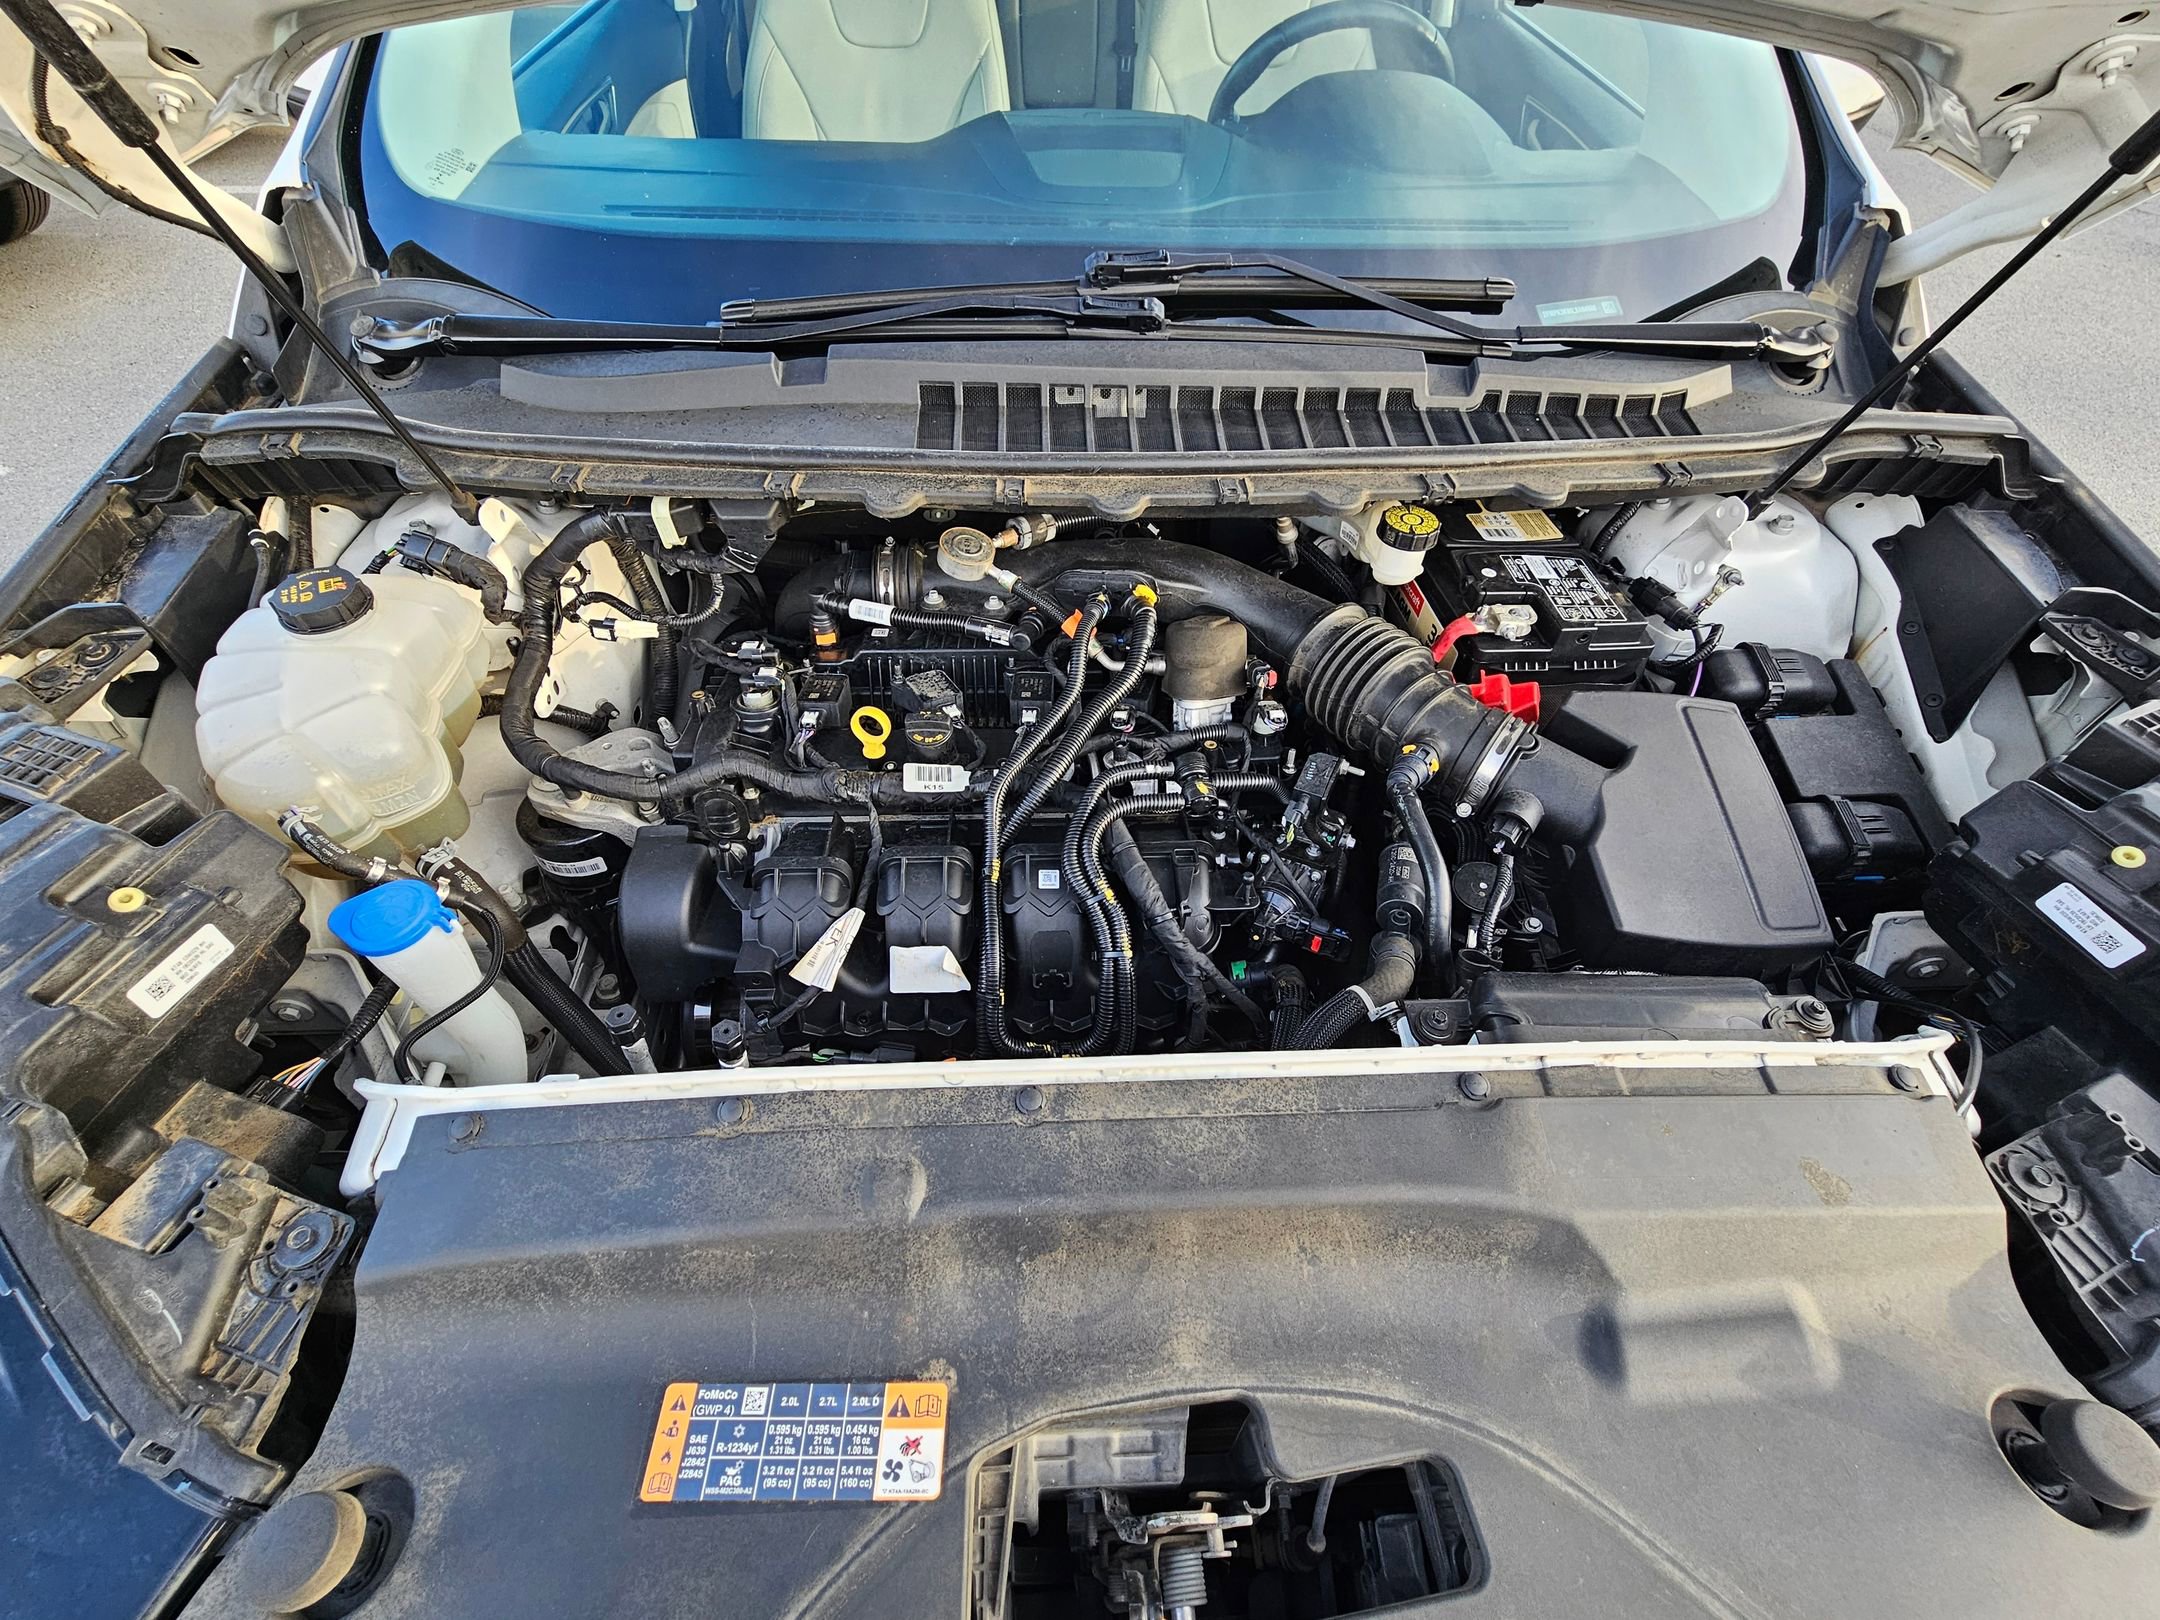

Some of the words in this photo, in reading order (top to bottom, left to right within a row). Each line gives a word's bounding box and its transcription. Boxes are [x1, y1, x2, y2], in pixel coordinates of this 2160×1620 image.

[698, 1389, 738, 1400] FoMoCo
[780, 1396, 800, 1406] 2.0L
[818, 1396, 838, 1406] 2.7L
[851, 1396, 871, 1406] 2.0L
[872, 1396, 880, 1406] D
[692, 1404, 722, 1416] (GWP
[723, 1404, 735, 1416] 4)
[768, 1424, 791, 1435] 0.595
[792, 1424, 803, 1437] kg
[807, 1424, 830, 1435] 0.595
[831, 1424, 841, 1437] kg
[845, 1424, 868, 1435] 0.454
[869, 1424, 880, 1437] kg
[689, 1434, 709, 1444] SAE
[774, 1436, 783, 1444] 21
[813, 1436, 822, 1444] 21
[852, 1436, 861, 1444] 16
[686, 1446, 707, 1455] J639
[716, 1442, 759, 1455] R-1234yf
[769, 1446, 783, 1454] 1.31
[784, 1446, 795, 1454] lbs
[808, 1446, 823, 1454] 1.31
[824, 1446, 834, 1454] lbs
[847, 1446, 861, 1454] 1.00
[862, 1446, 873, 1454] lbs
[681, 1457, 706, 1467] J2842
[678, 1469, 704, 1479] J2845
[762, 1466, 776, 1475] 3.2
[776, 1466, 784, 1475] fl
[784, 1467, 795, 1475] oz
[802, 1466, 815, 1475] 3.2
[816, 1466, 823, 1475] fl
[824, 1467, 834, 1475] oz
[840, 1466, 854, 1475] 5.4
[855, 1466, 861, 1475] fl
[862, 1467, 873, 1475] oz
[719, 1475, 741, 1486] PAG
[763, 1478, 777, 1489] (95
[778, 1478, 792, 1489] cc)
[803, 1478, 817, 1489] (95
[818, 1478, 831, 1489] cc)
[839, 1478, 858, 1489] (160
[859, 1478, 873, 1489] cc)
